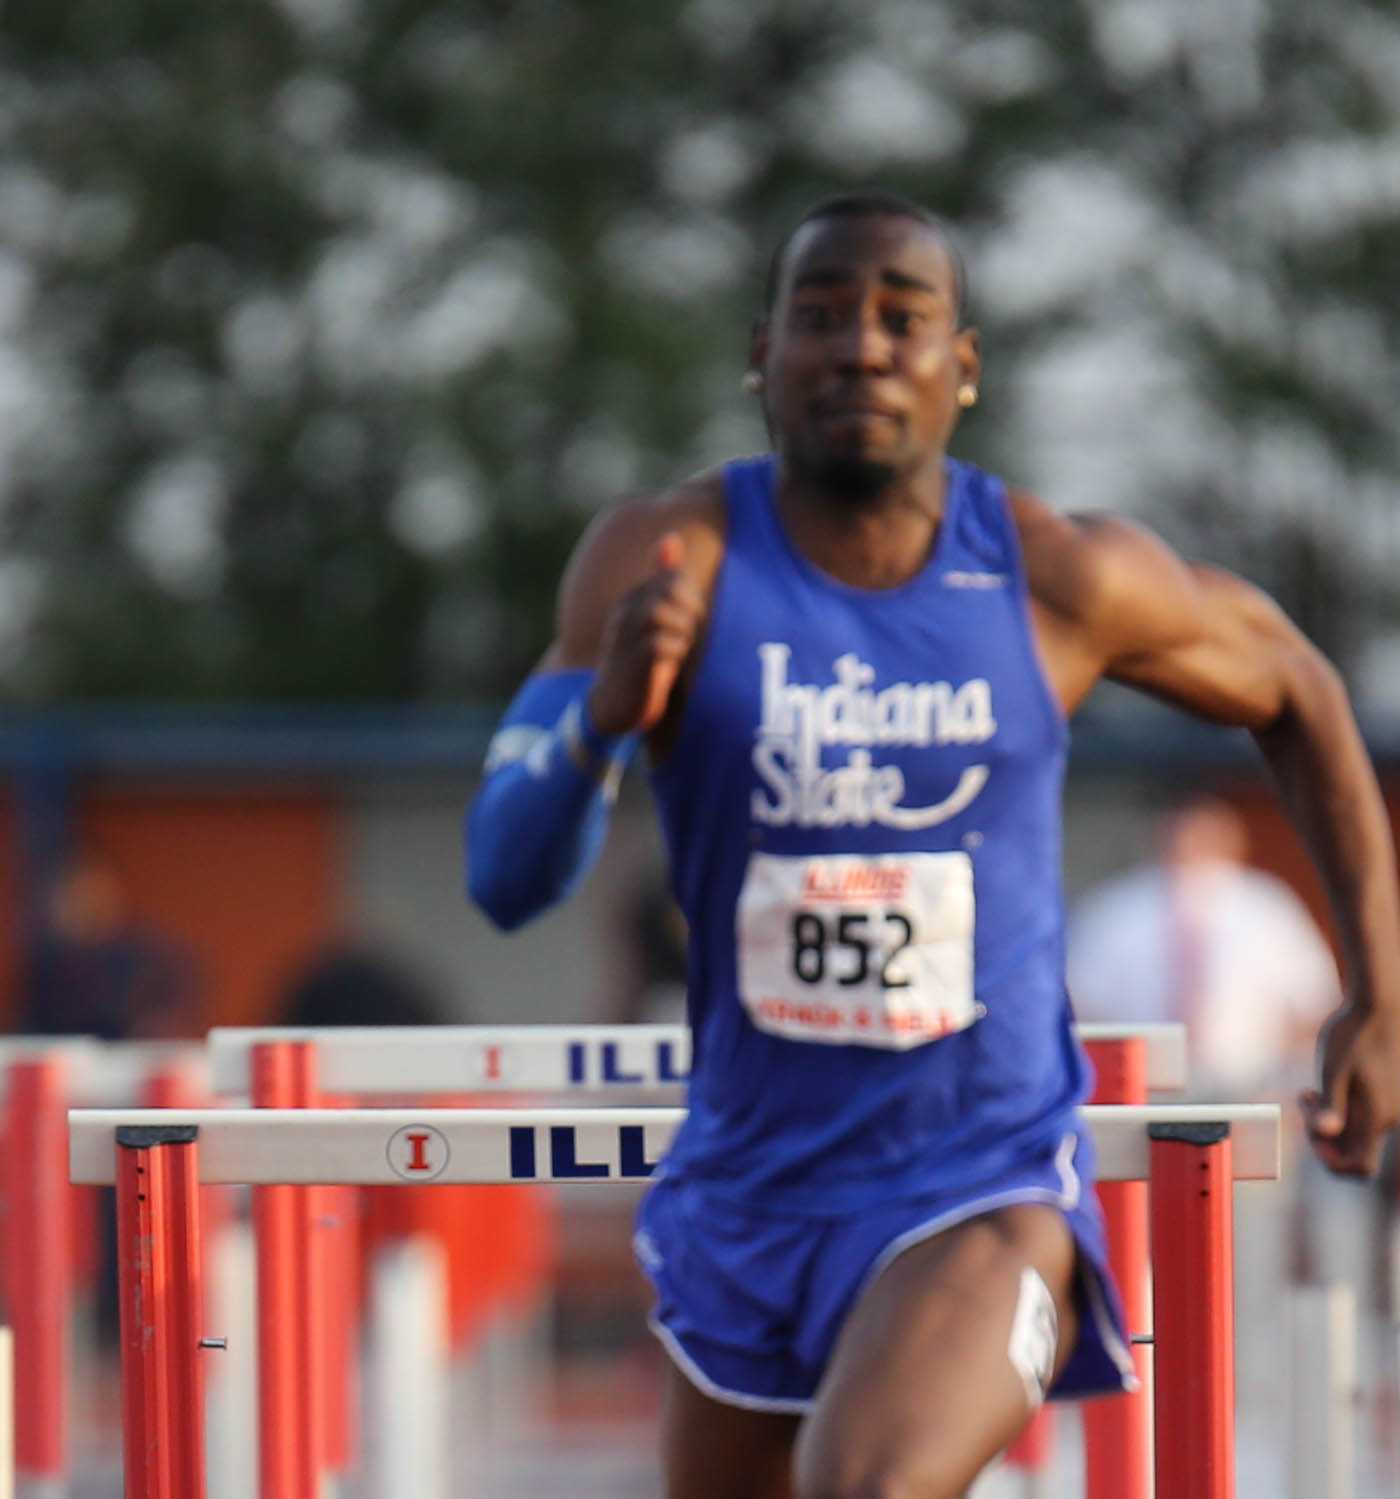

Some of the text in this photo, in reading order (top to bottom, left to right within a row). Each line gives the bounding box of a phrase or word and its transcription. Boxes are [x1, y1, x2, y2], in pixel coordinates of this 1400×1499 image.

[756, 641, 998, 745] Indiana
[751, 740, 992, 830] State
[792, 911, 913, 988] 852
